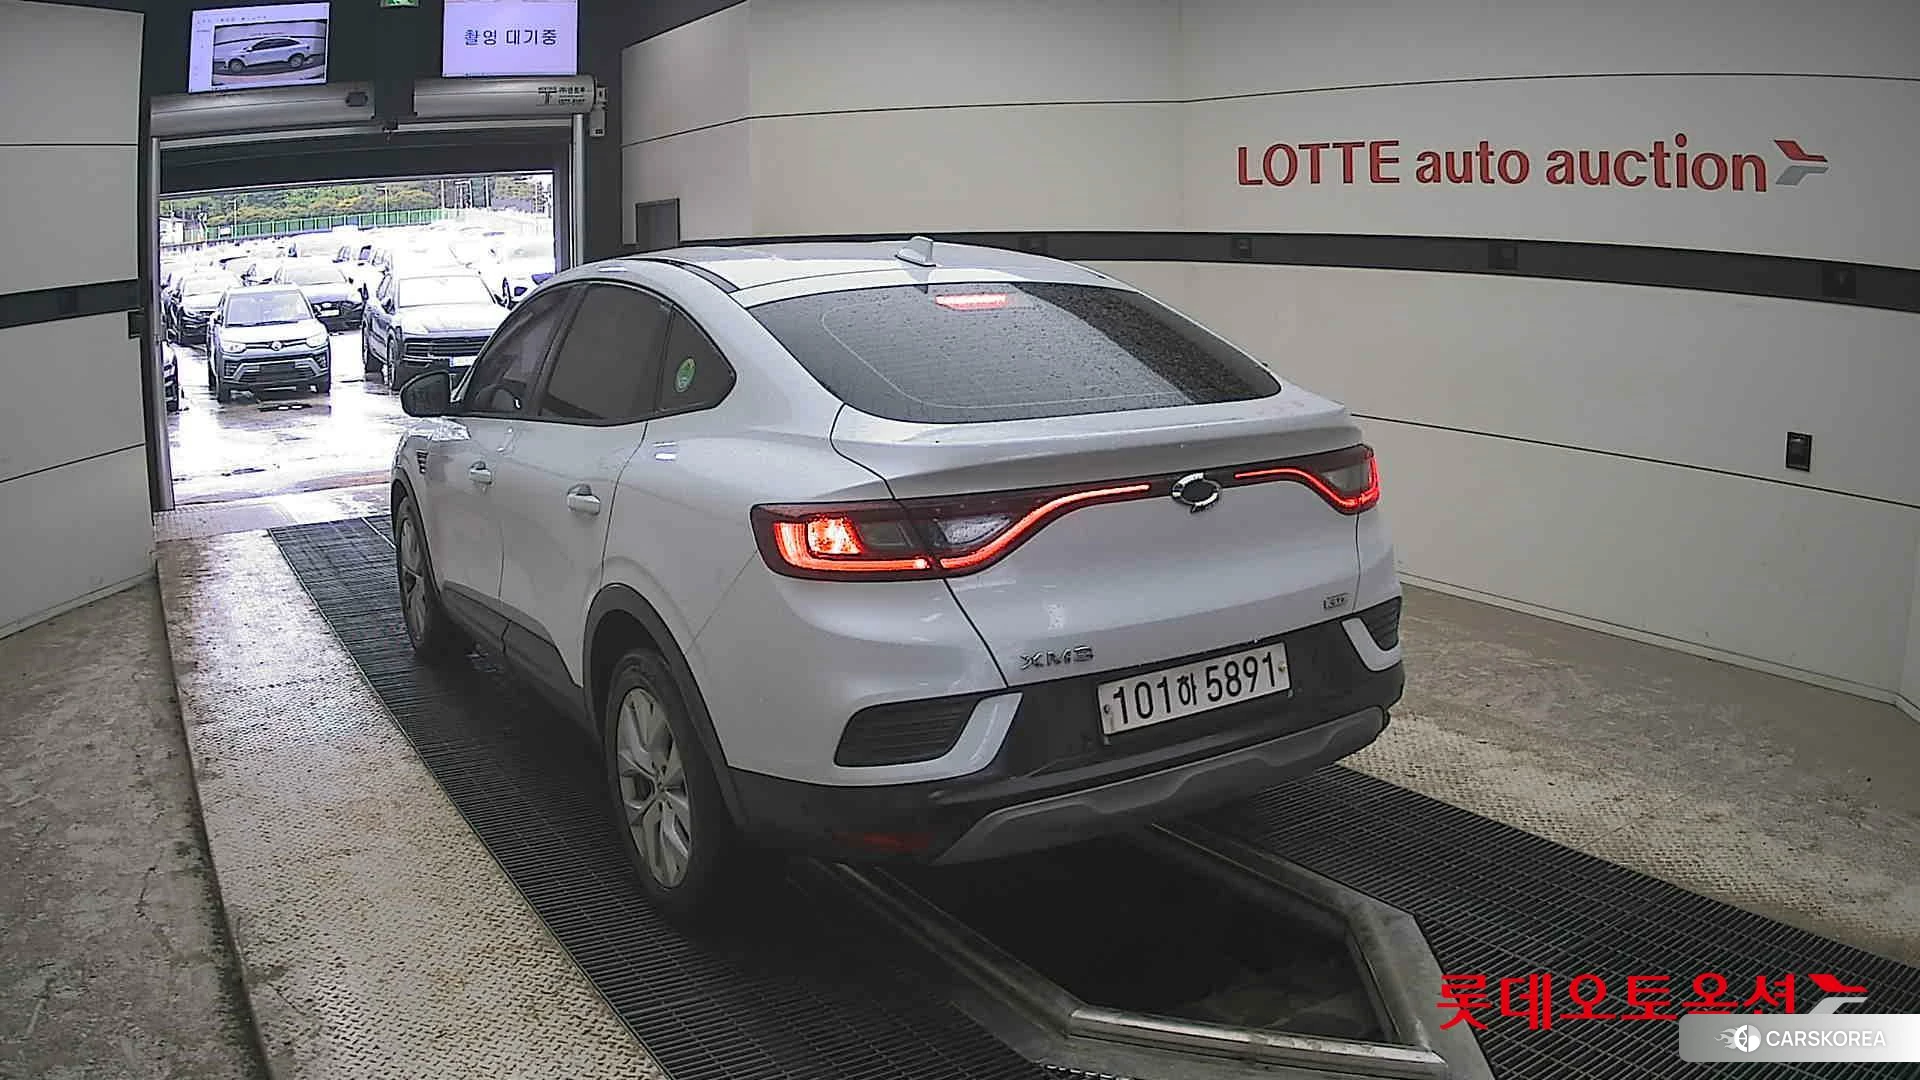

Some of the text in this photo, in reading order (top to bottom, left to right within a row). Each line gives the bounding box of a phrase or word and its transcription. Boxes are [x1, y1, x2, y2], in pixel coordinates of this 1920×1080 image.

[464, 29, 558, 46] 촬영 대기중
[1237, 132, 1768, 193] LOTTE auto auction
[1113, 651, 1276, 725] 101하 5891
